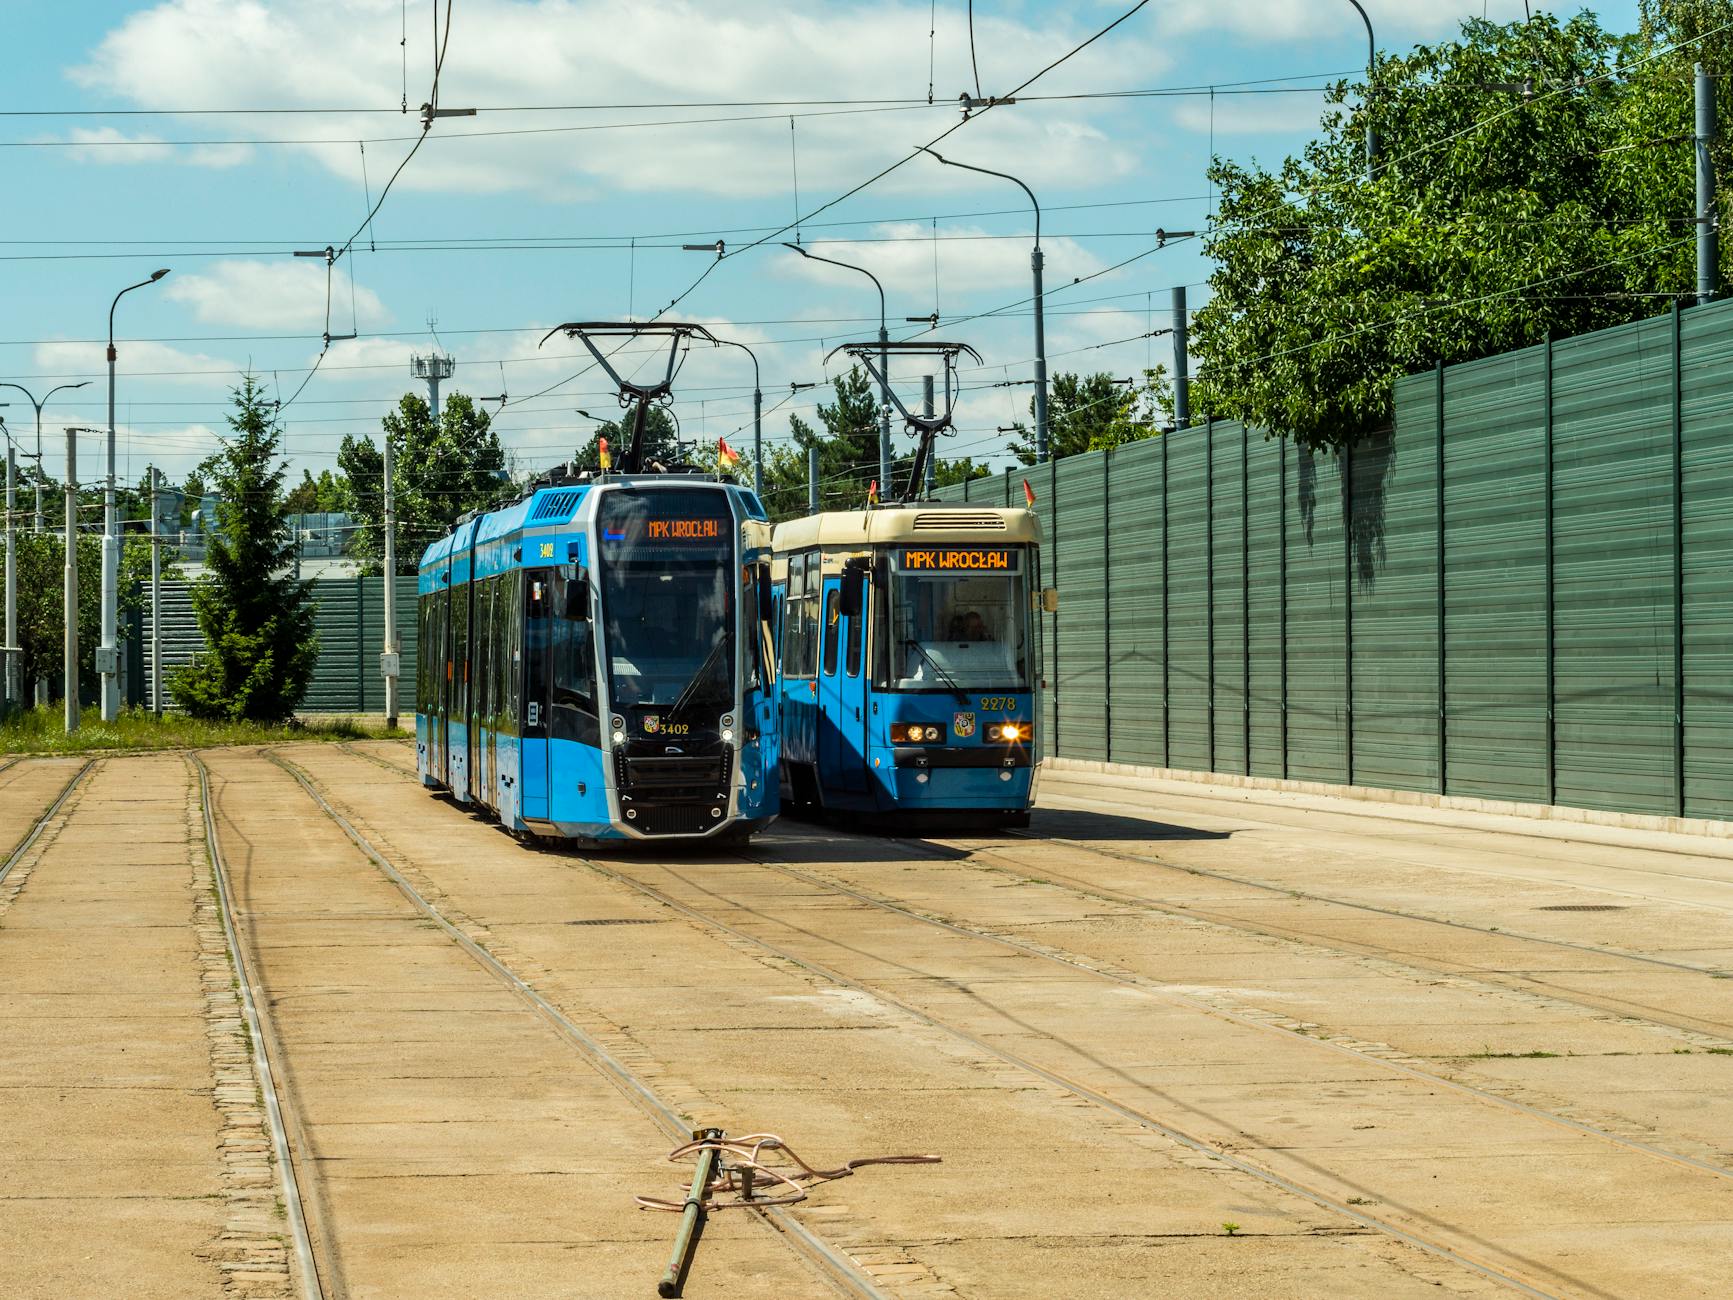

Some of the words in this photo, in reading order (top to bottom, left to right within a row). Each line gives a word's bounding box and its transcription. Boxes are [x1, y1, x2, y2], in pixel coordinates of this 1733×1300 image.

[648, 520, 670, 538] MPK
[671, 520, 718, 538] WROCŁAW
[905, 551, 935, 569] MPK
[939, 551, 1008, 569] WROCŁAW
[980, 697, 1016, 711] 2278
[660, 724, 689, 735] 3402
